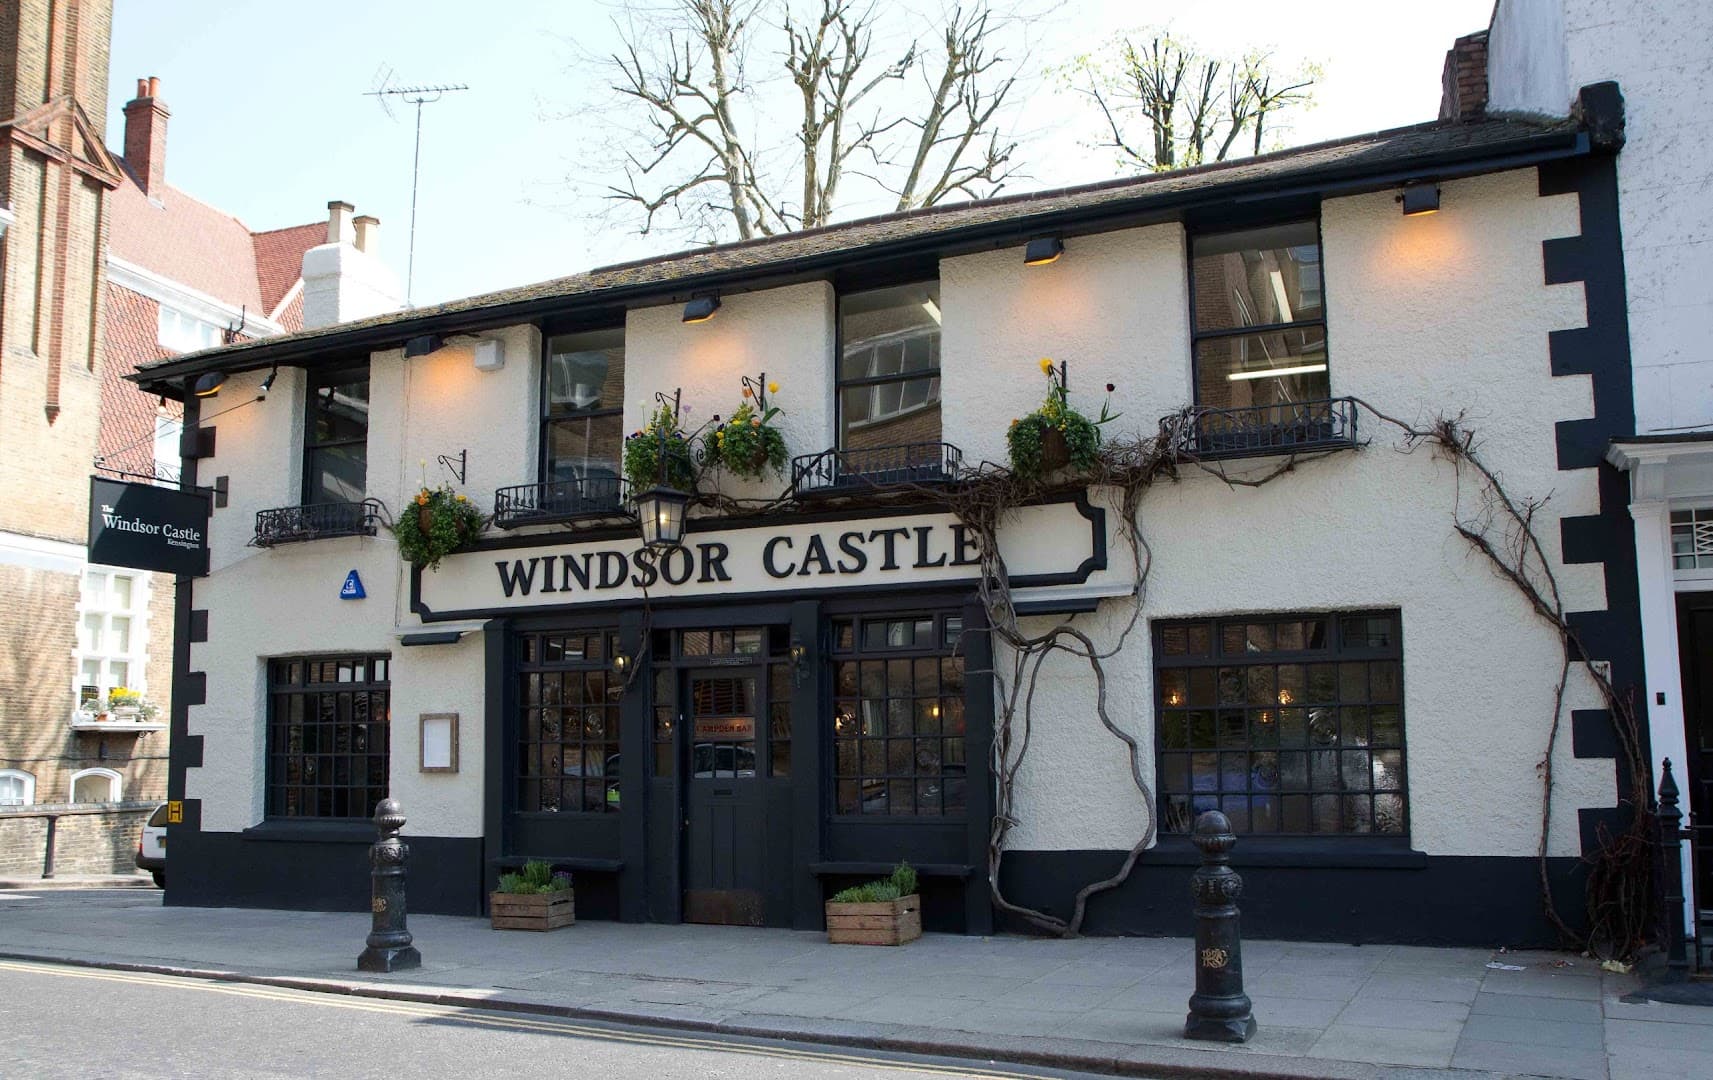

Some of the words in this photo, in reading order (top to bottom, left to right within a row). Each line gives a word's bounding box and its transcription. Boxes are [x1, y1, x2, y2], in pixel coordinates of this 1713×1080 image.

[101, 504, 114, 513] The
[102, 513, 160, 535] Windsor
[162, 524, 200, 541] Castle
[494, 542, 732, 598] WINDSOR
[763, 524, 982, 579] CASTLE
[170, 803, 181, 820] H
